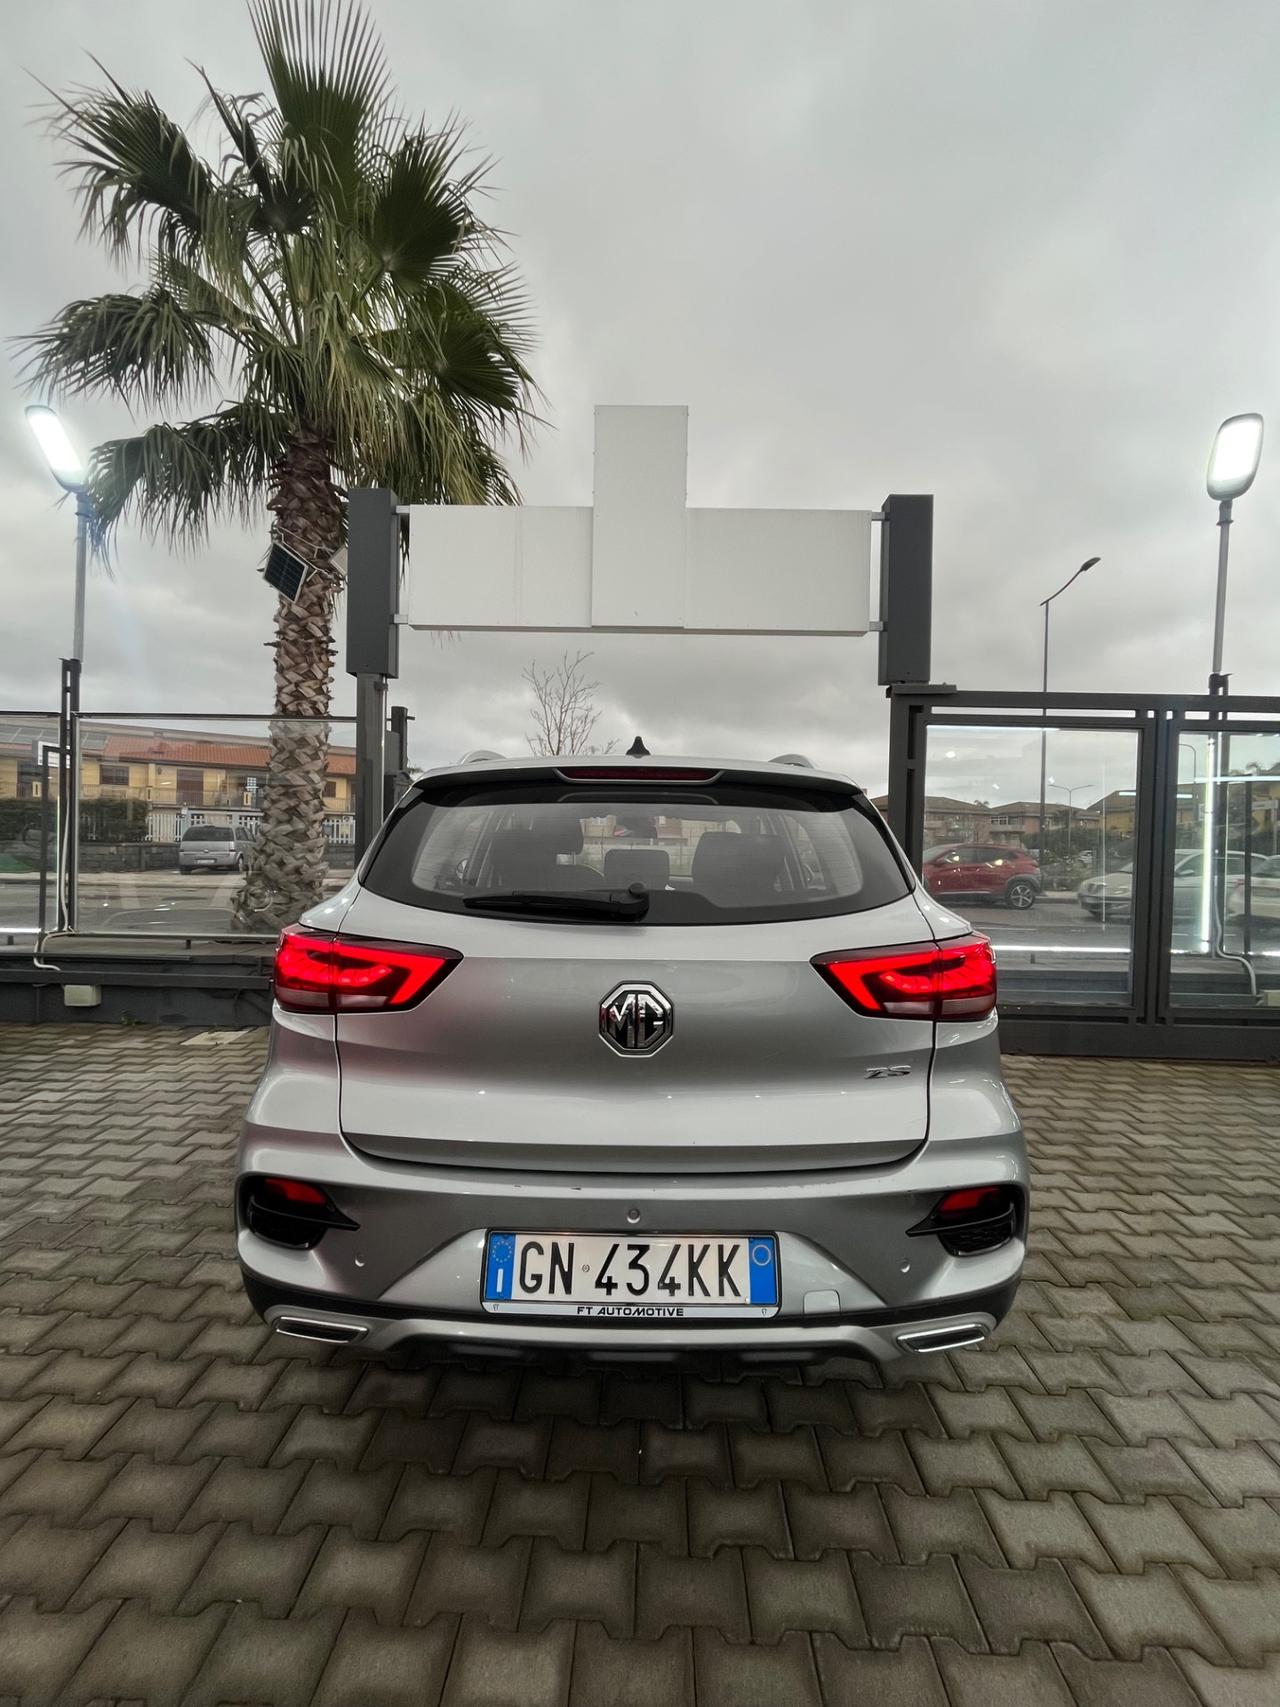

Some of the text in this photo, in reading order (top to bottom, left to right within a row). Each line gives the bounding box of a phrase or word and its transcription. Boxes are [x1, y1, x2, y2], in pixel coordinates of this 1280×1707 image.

[607, 993, 664, 1049] MG
[865, 1065, 911, 1079] ZS
[519, 1241, 742, 1297] GN 434KK
[576, 1306, 684, 1317] FT AUTOMOTIVE
